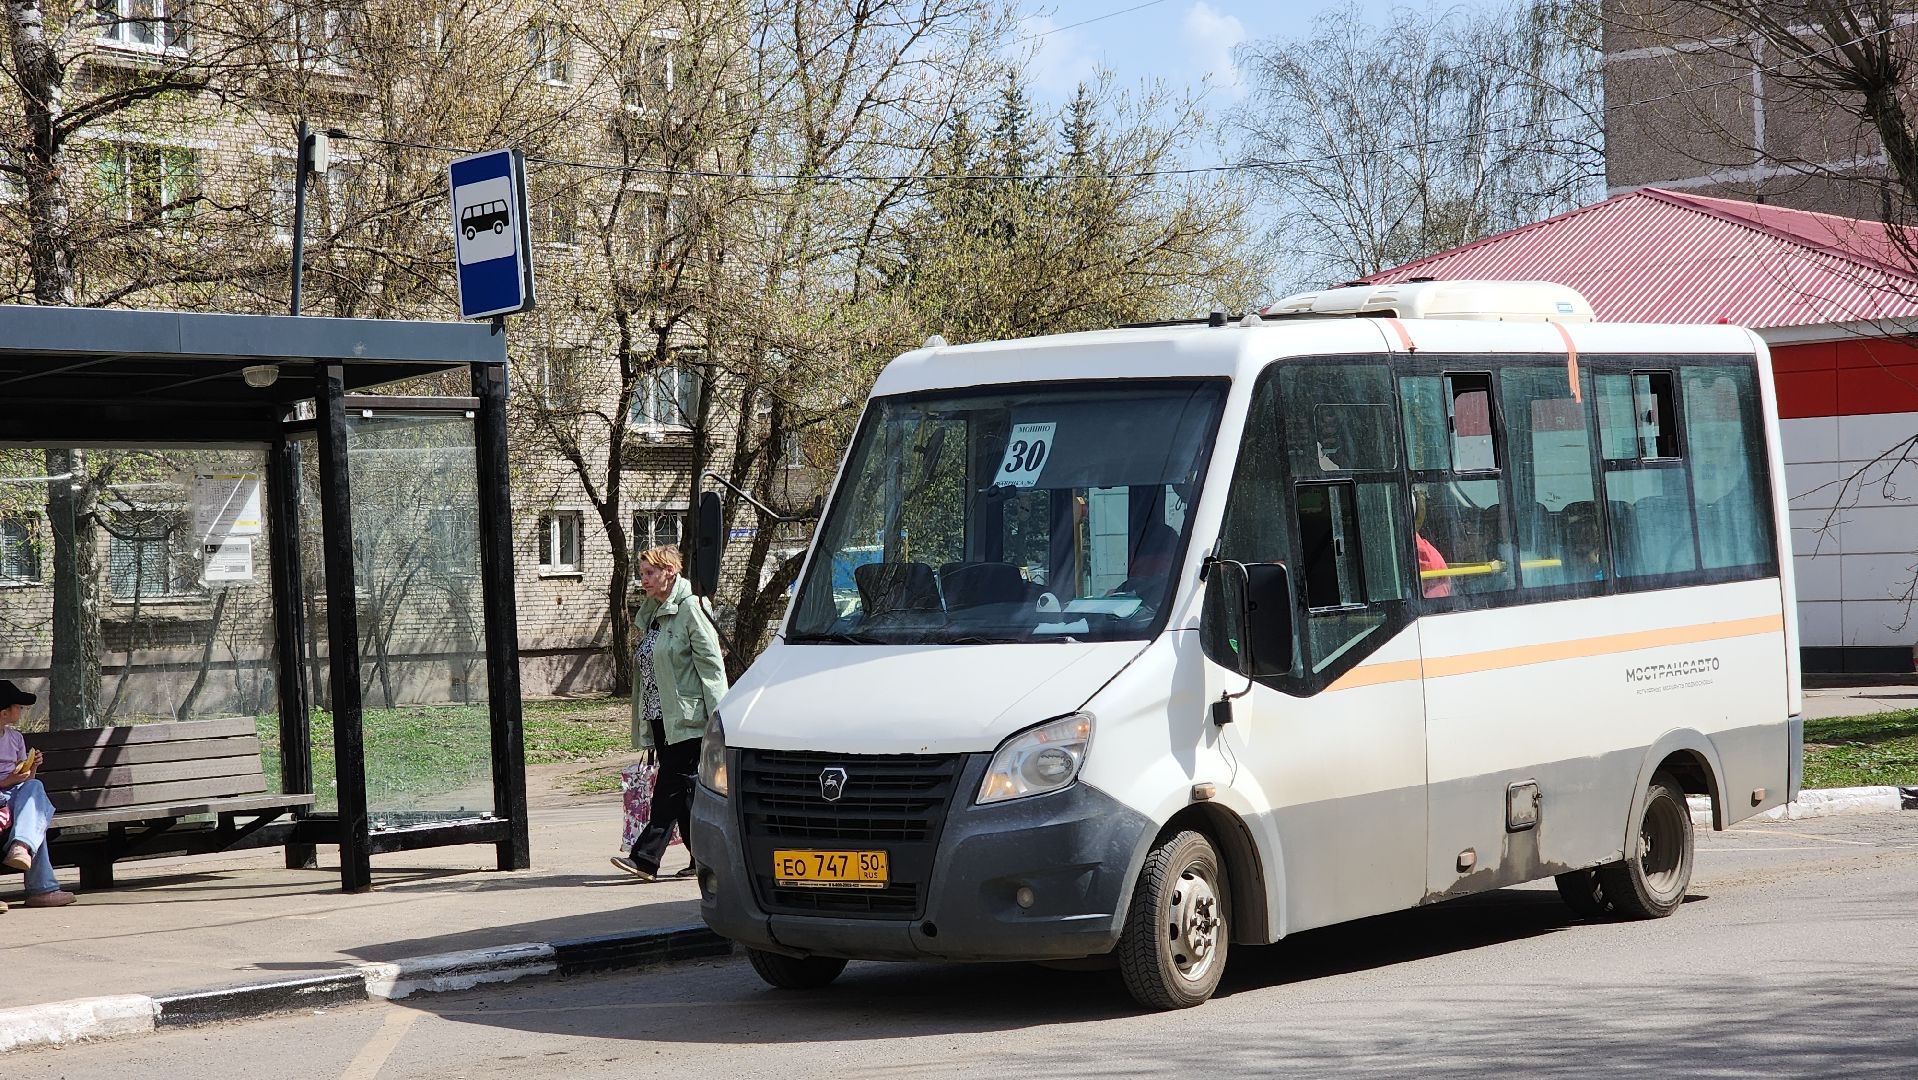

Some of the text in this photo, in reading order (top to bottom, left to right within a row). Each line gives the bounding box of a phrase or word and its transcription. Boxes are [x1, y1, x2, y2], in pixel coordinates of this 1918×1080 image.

[1005, 439, 1046, 473] 30
[1626, 657, 1720, 682] МОСТРАНСАВТО
[814, 855, 848, 877] 747
[860, 854, 879, 871] 50
